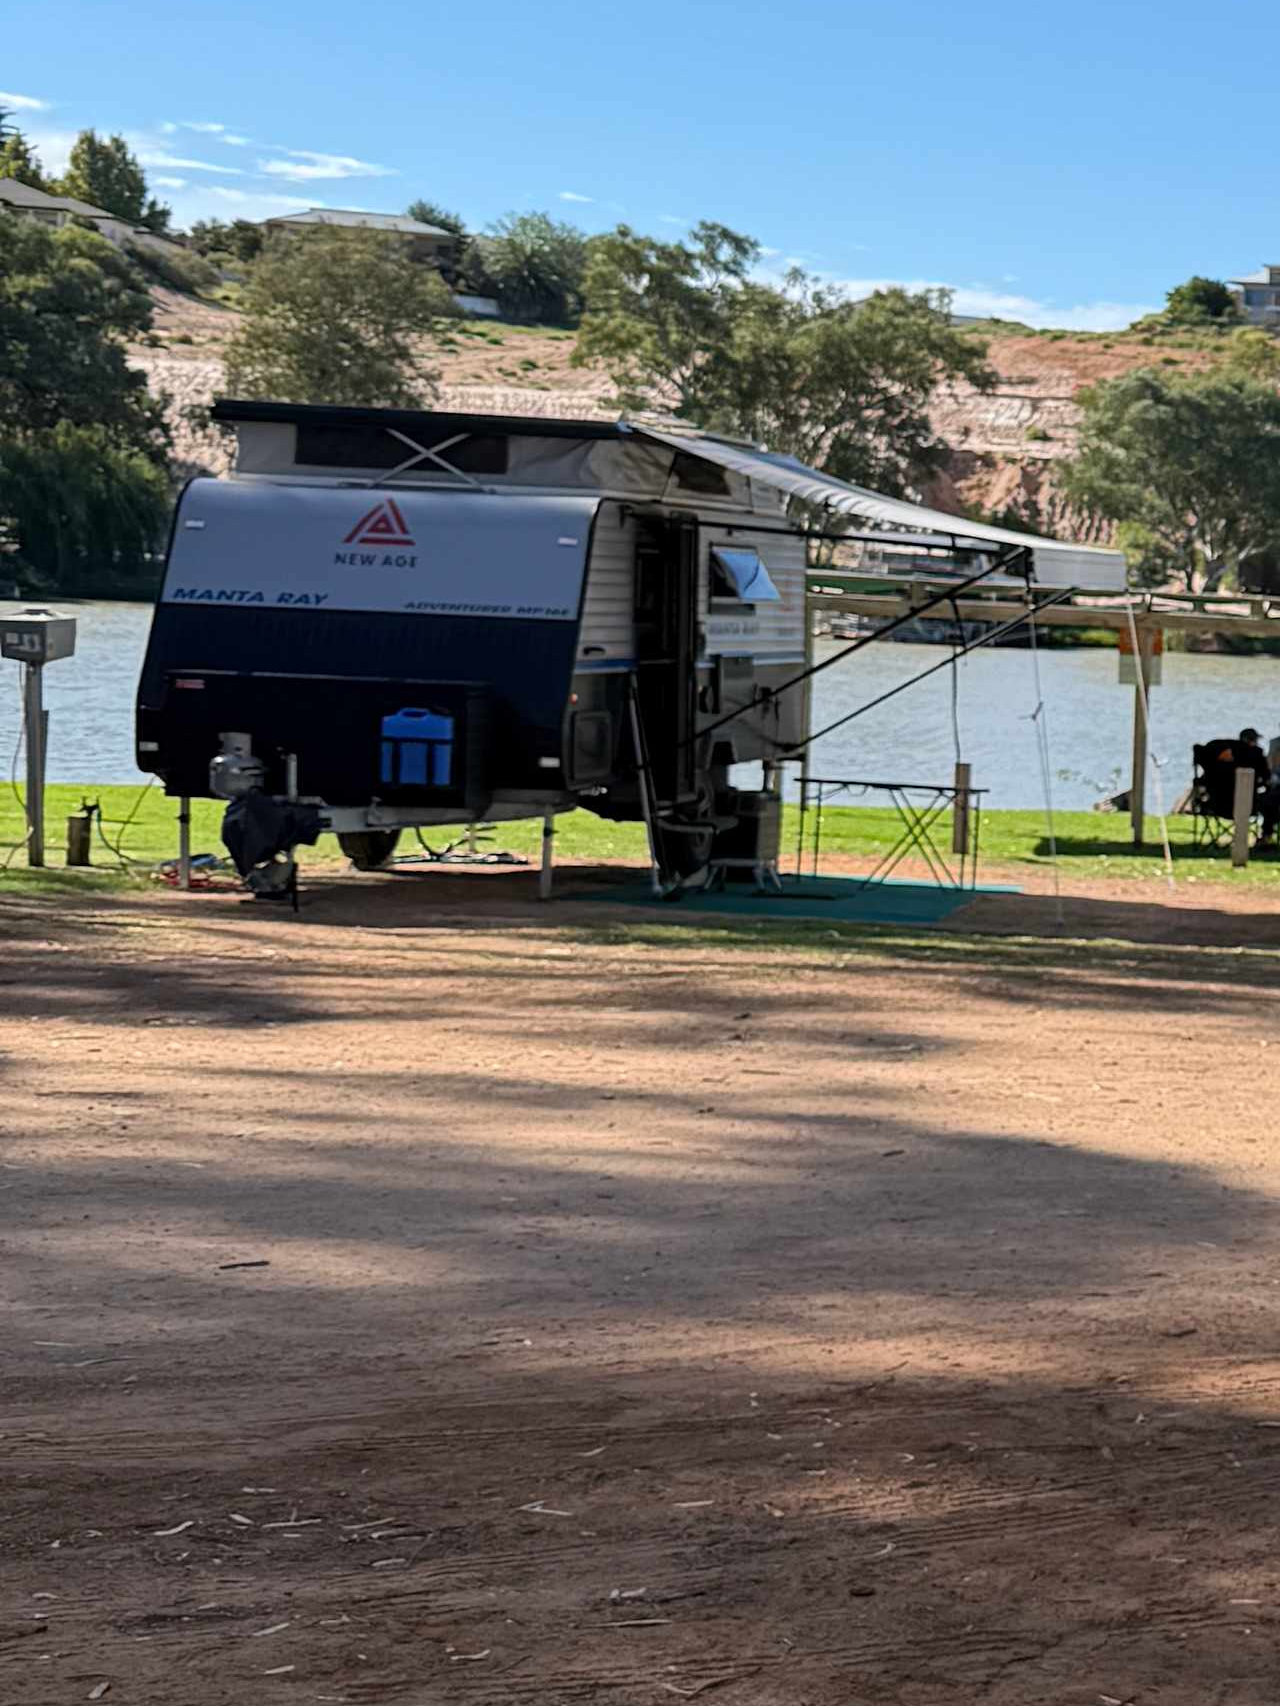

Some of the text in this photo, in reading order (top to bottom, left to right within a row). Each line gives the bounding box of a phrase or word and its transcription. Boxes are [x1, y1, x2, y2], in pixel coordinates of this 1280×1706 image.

[334, 552, 419, 568] NEW AGE
[173, 587, 329, 606] MANTA RAY
